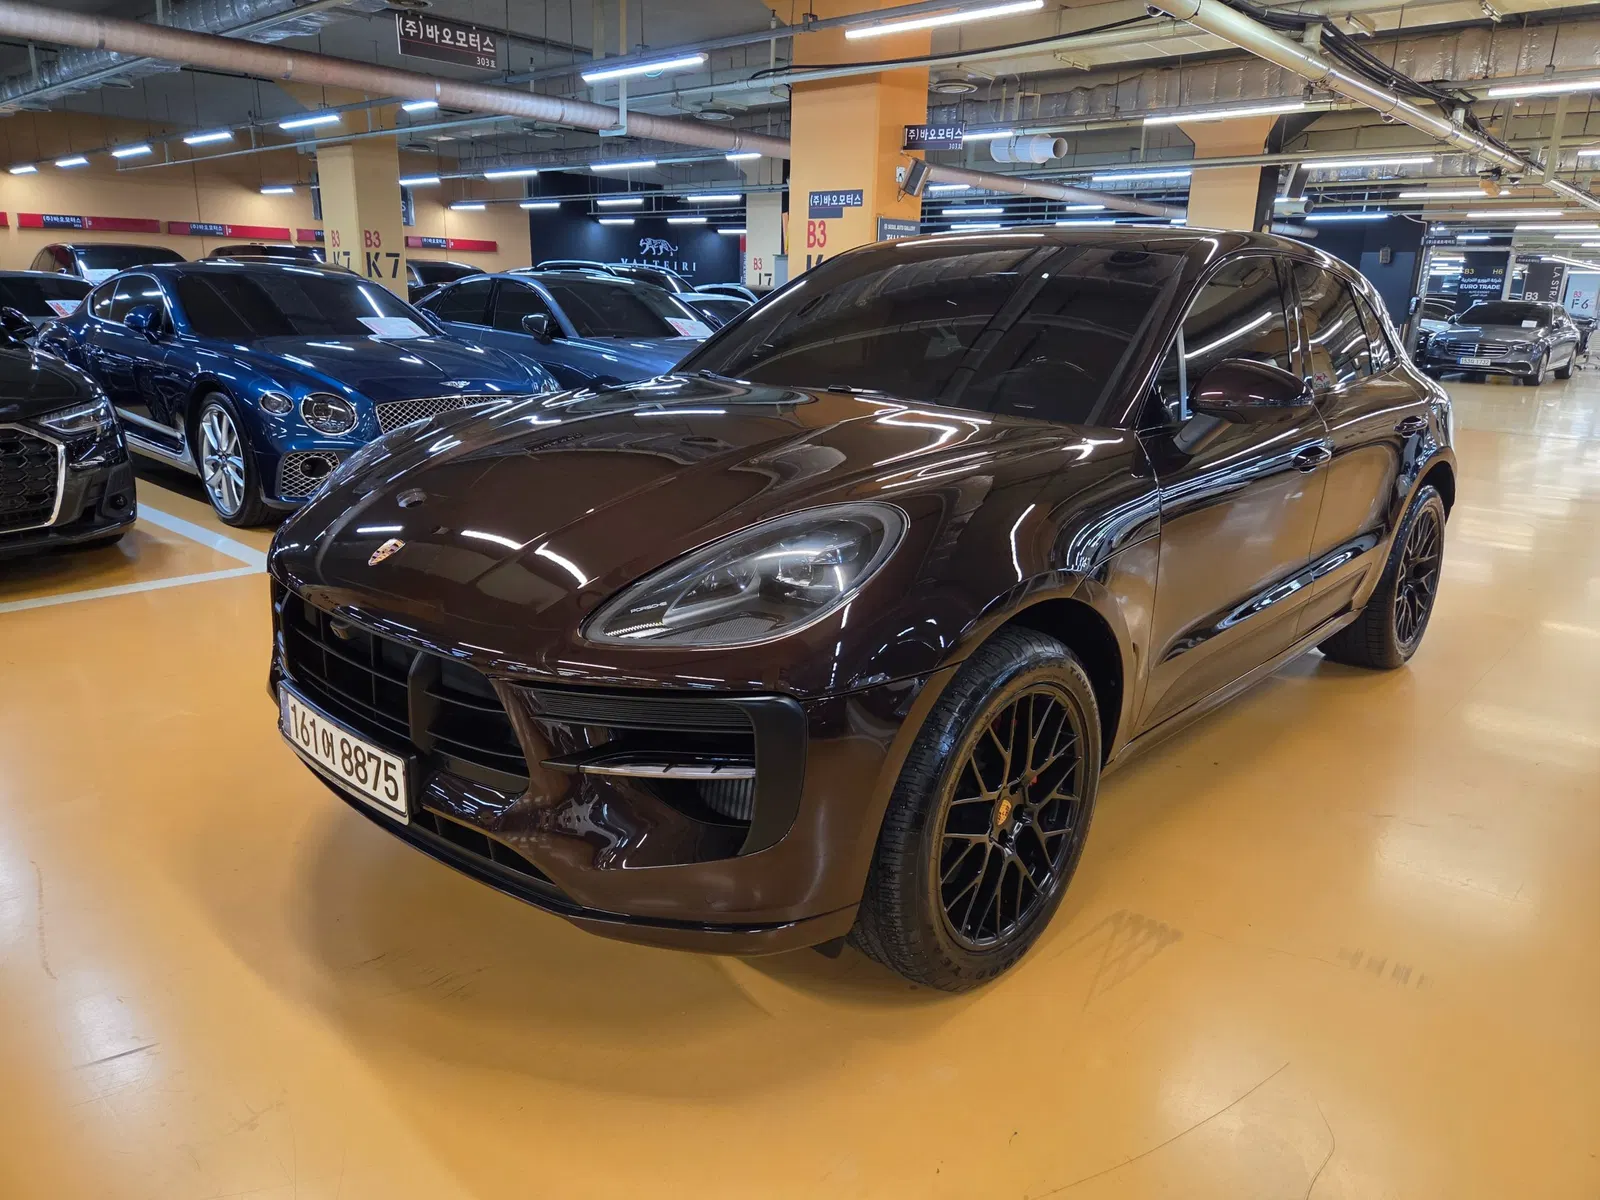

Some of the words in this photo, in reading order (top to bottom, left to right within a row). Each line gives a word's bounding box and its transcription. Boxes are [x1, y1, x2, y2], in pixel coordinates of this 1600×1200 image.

[400, 17, 495, 52] (주)바오모터스
[477, 57, 496, 68] 303호
[810, 194, 861, 206] (주)바오모터스
[331, 230, 340, 247] B3
[364, 230, 381, 248] B3
[807, 220, 827, 248] B3
[366, 252, 400, 278] K7
[754, 257, 763, 270] B3
[1525, 292, 1539, 300] B3
[630, 601, 667, 613] PORSCHE
[291, 703, 336, 765] 161어
[340, 737, 399, 802] 8875
